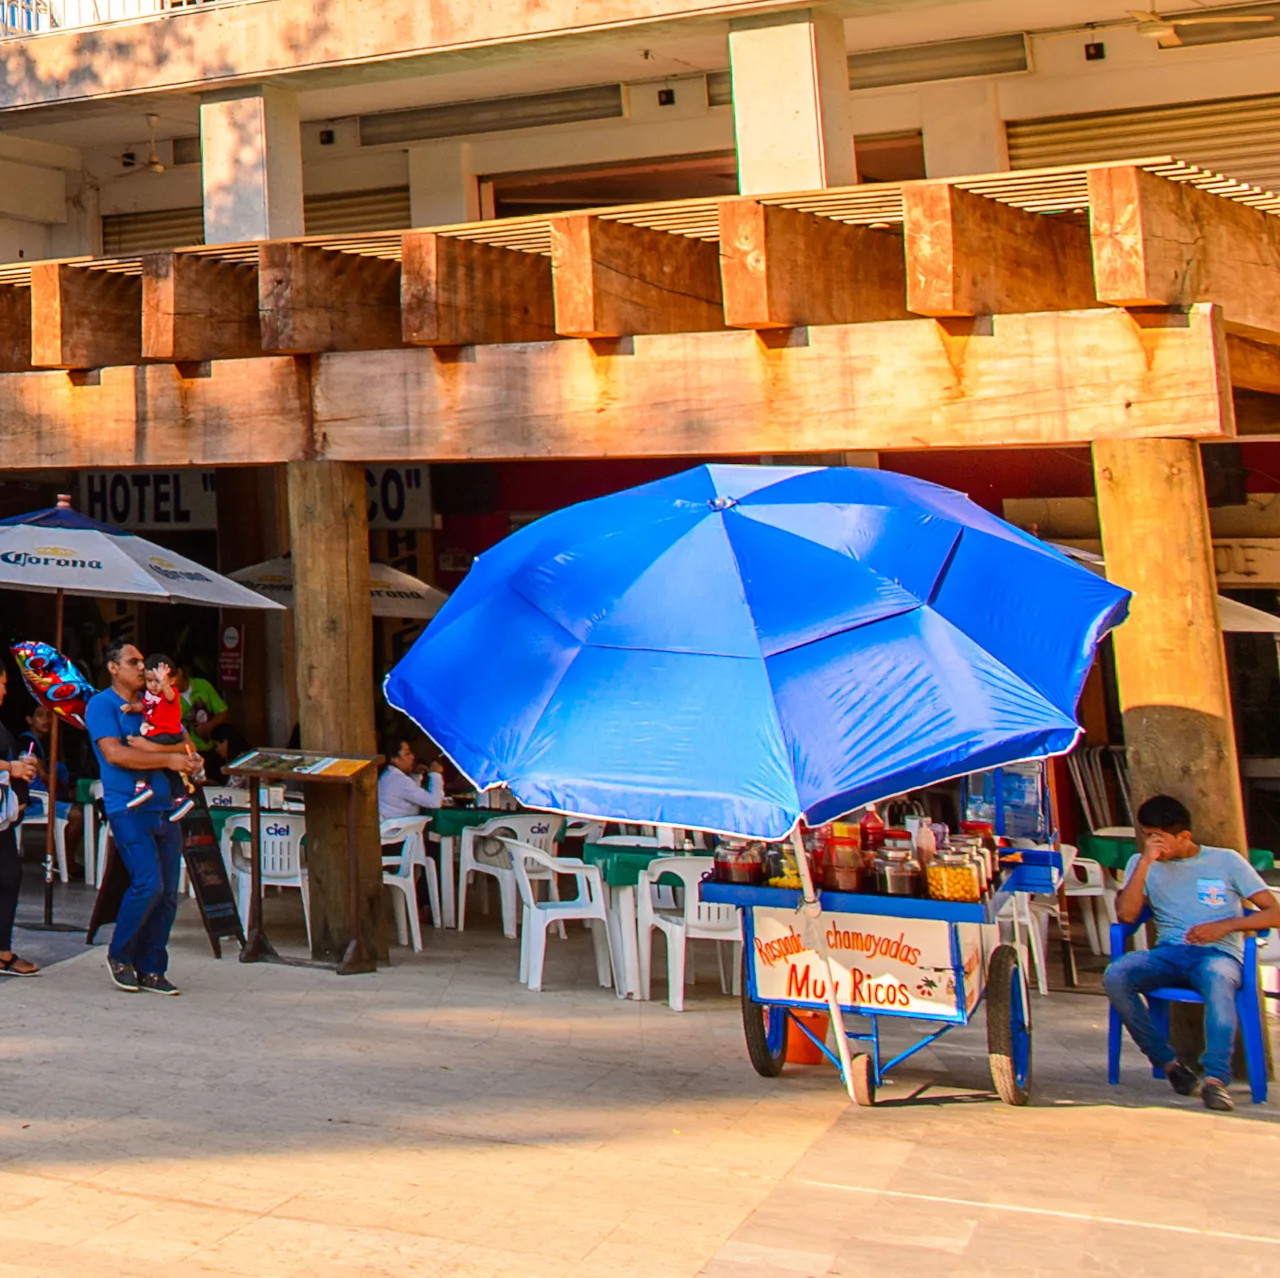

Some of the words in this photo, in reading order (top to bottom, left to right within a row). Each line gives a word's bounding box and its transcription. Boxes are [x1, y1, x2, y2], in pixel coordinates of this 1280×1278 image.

[89, 474, 190, 523] HOTEL
[0, 551, 102, 569] Corona
[212, 795, 232, 805] ciel
[266, 823, 290, 836] ciel
[530, 823, 549, 834] ciel
[826, 921, 921, 966] chamoyadas
[851, 967, 909, 1006] Ricos
